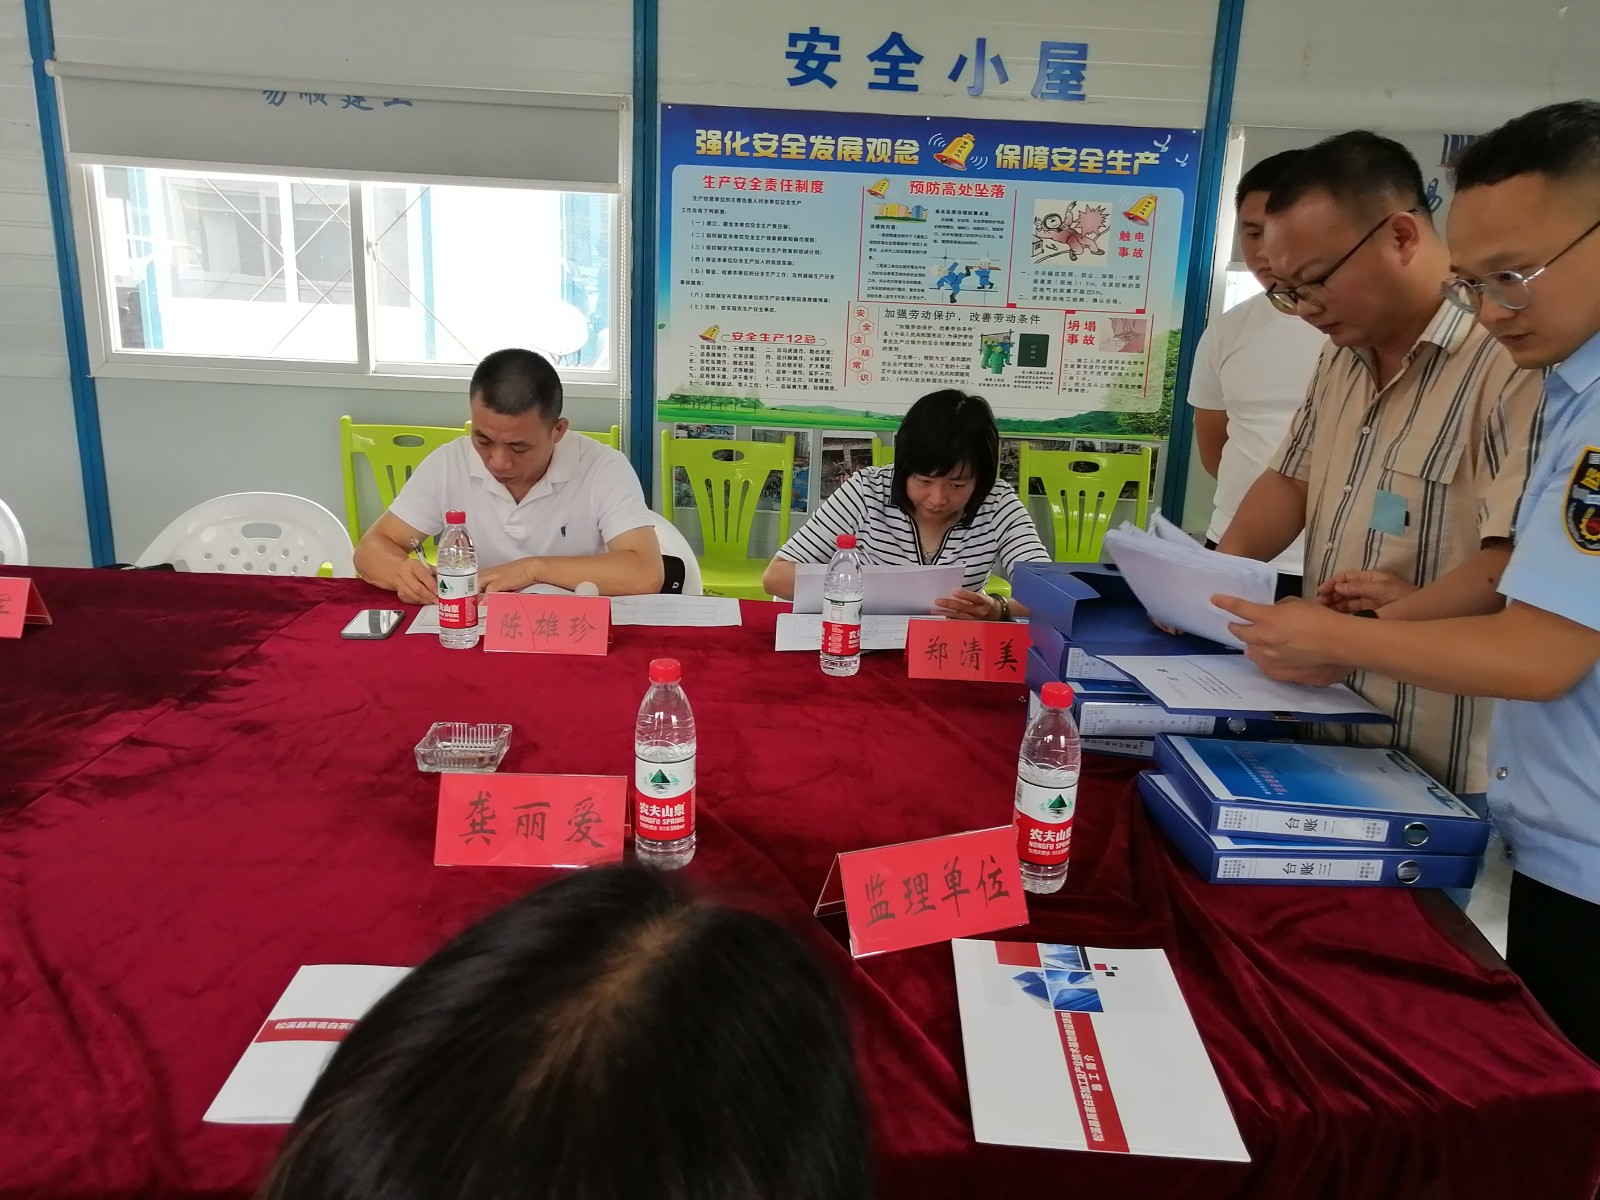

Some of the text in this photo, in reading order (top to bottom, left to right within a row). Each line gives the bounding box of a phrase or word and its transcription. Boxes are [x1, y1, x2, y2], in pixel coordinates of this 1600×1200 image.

[784, 26, 1090, 101] 安全小屋
[695, 128, 920, 166] 强化安全发展观念
[994, 143, 1161, 177] 保障安全生产
[702, 175, 824, 194] 生产安全责任制度
[909, 180, 1006, 199] 预防高处坠落
[1119, 230, 1146, 243] 触电
[1118, 247, 1144, 259] 事故
[884, 308, 1041, 325] 加强劳动保护，改善劳动条件
[1067, 320, 1096, 333] 坍塌
[732, 332, 816, 344] 安全生产12忌
[852, 308, 872, 382] 安全法规常识
[1066, 333, 1095, 346] 事故
[500, 611, 597, 643] 陈雄珍
[925, 636, 1018, 672] 郑清美
[639, 802, 685, 817] 农夫山泉
[458, 790, 605, 848] 龚丽爱
[1285, 818, 1337, 836] 台账二
[1029, 841, 1054, 849] NONGFU
[1282, 861, 1334, 877] 台账三
[865, 854, 1010, 928] 监理单位
